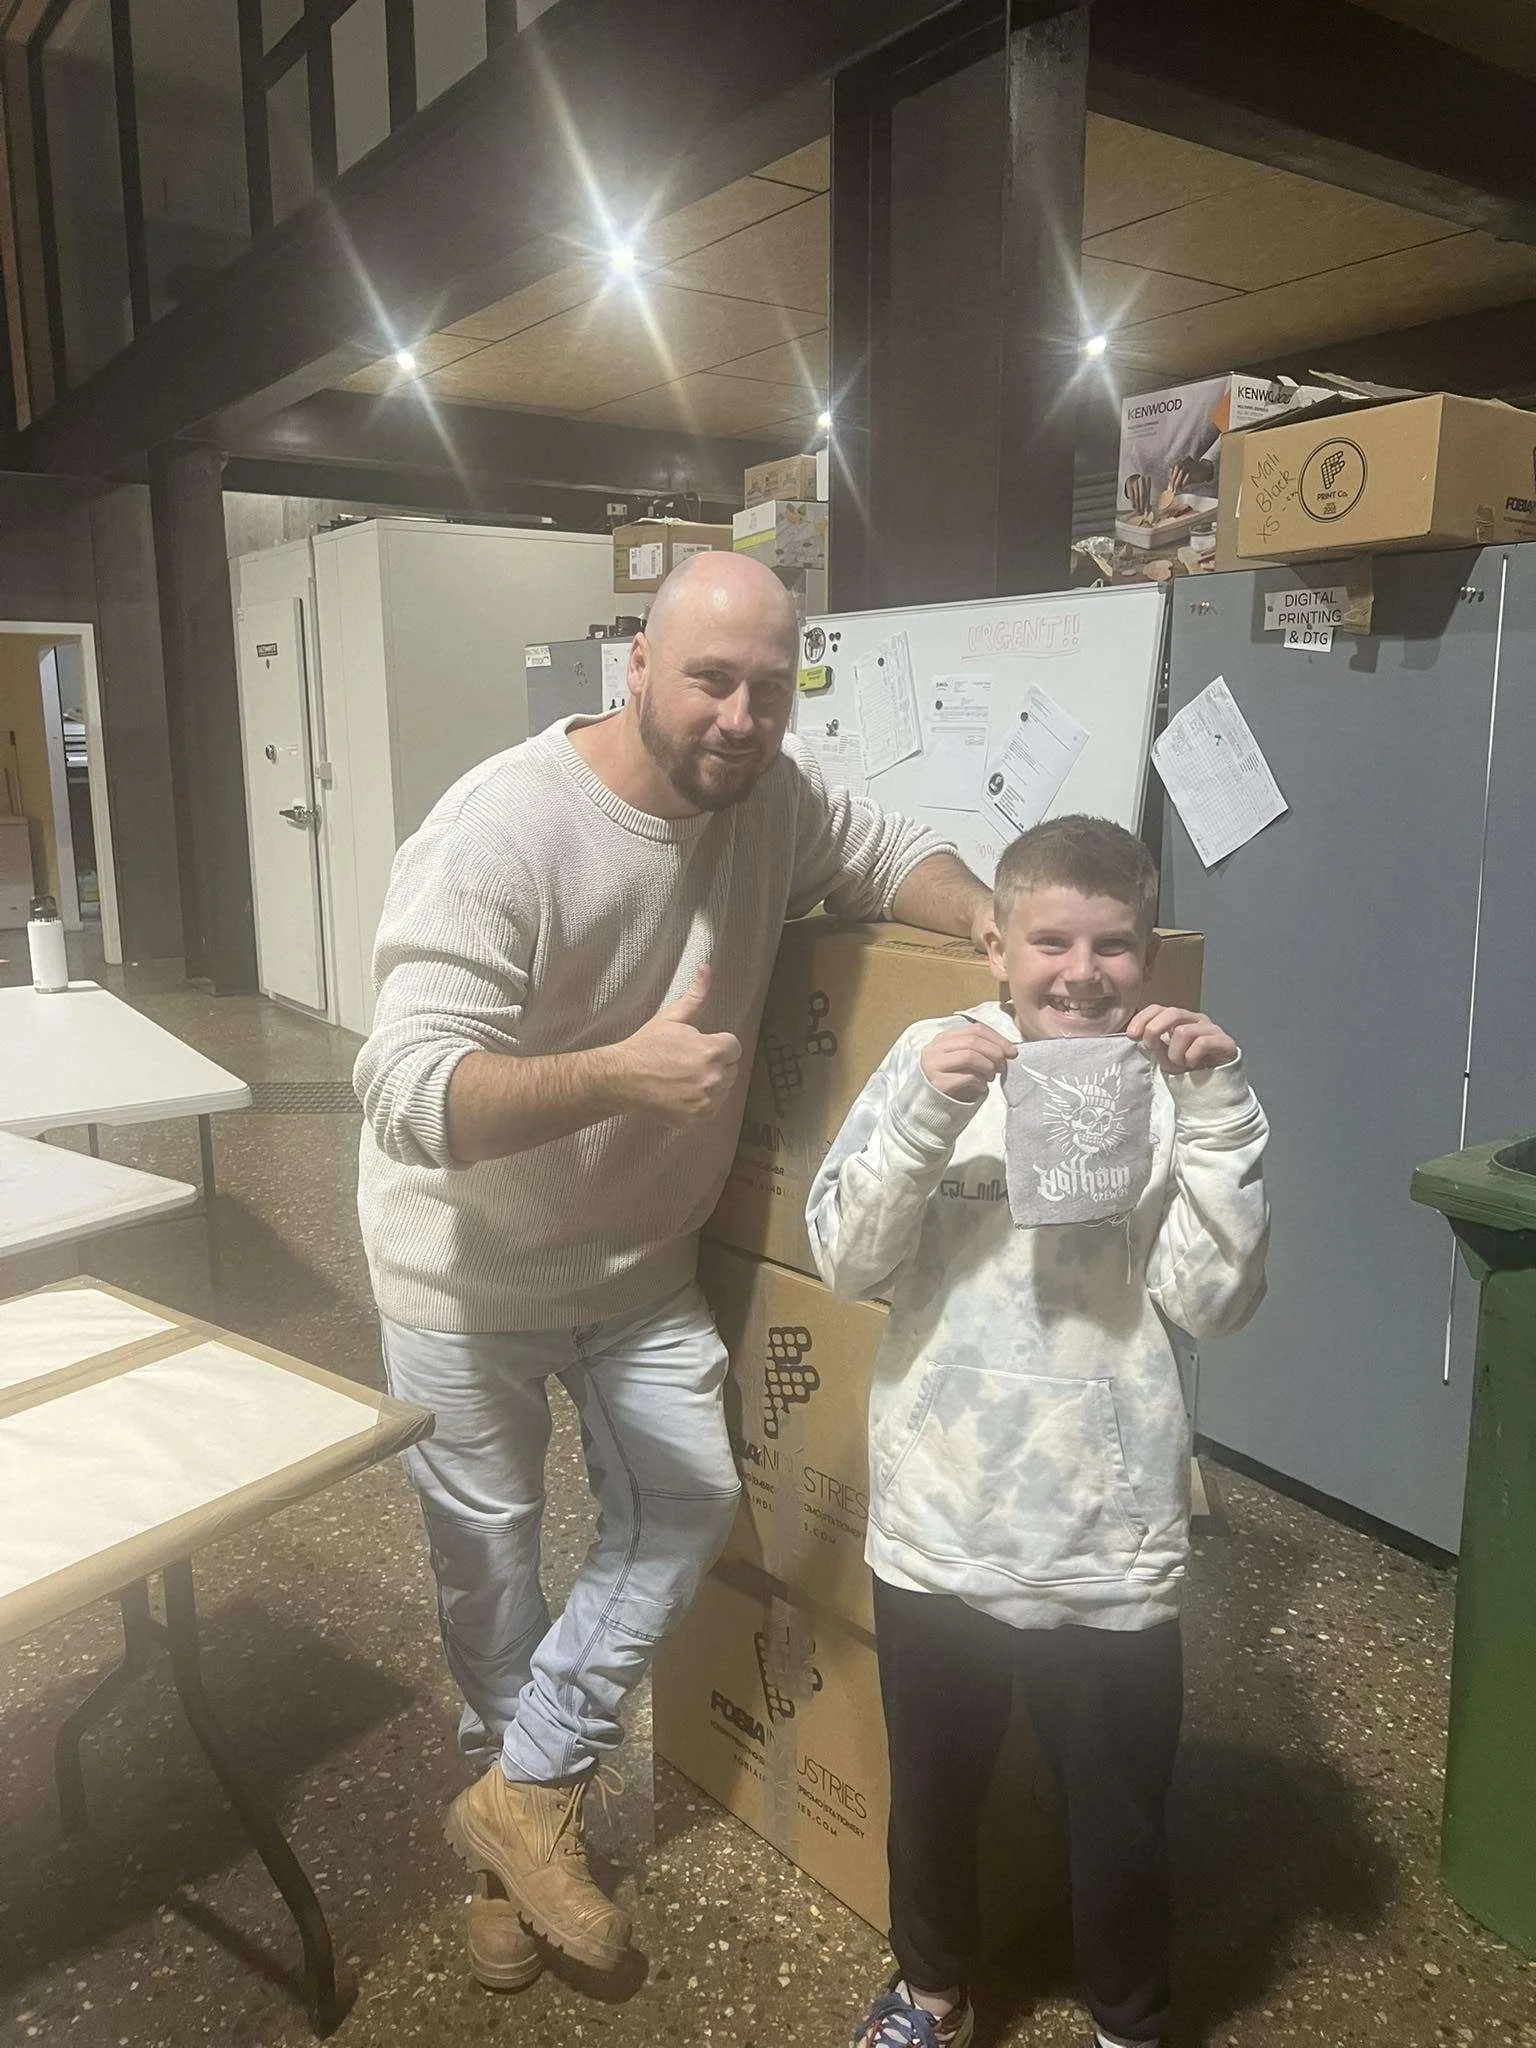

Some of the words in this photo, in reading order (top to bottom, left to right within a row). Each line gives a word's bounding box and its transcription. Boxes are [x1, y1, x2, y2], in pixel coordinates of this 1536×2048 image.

[1127, 398, 1183, 421] KENWOOD
[1255, 470, 1297, 512] Black
[1284, 591, 1337, 608] DIGITAL
[1278, 609, 1342, 626] PRINTING
[1289, 630, 1299, 643] &
[1303, 631, 1329, 645] DTG
[711, 1689, 765, 1747] FOBIA
